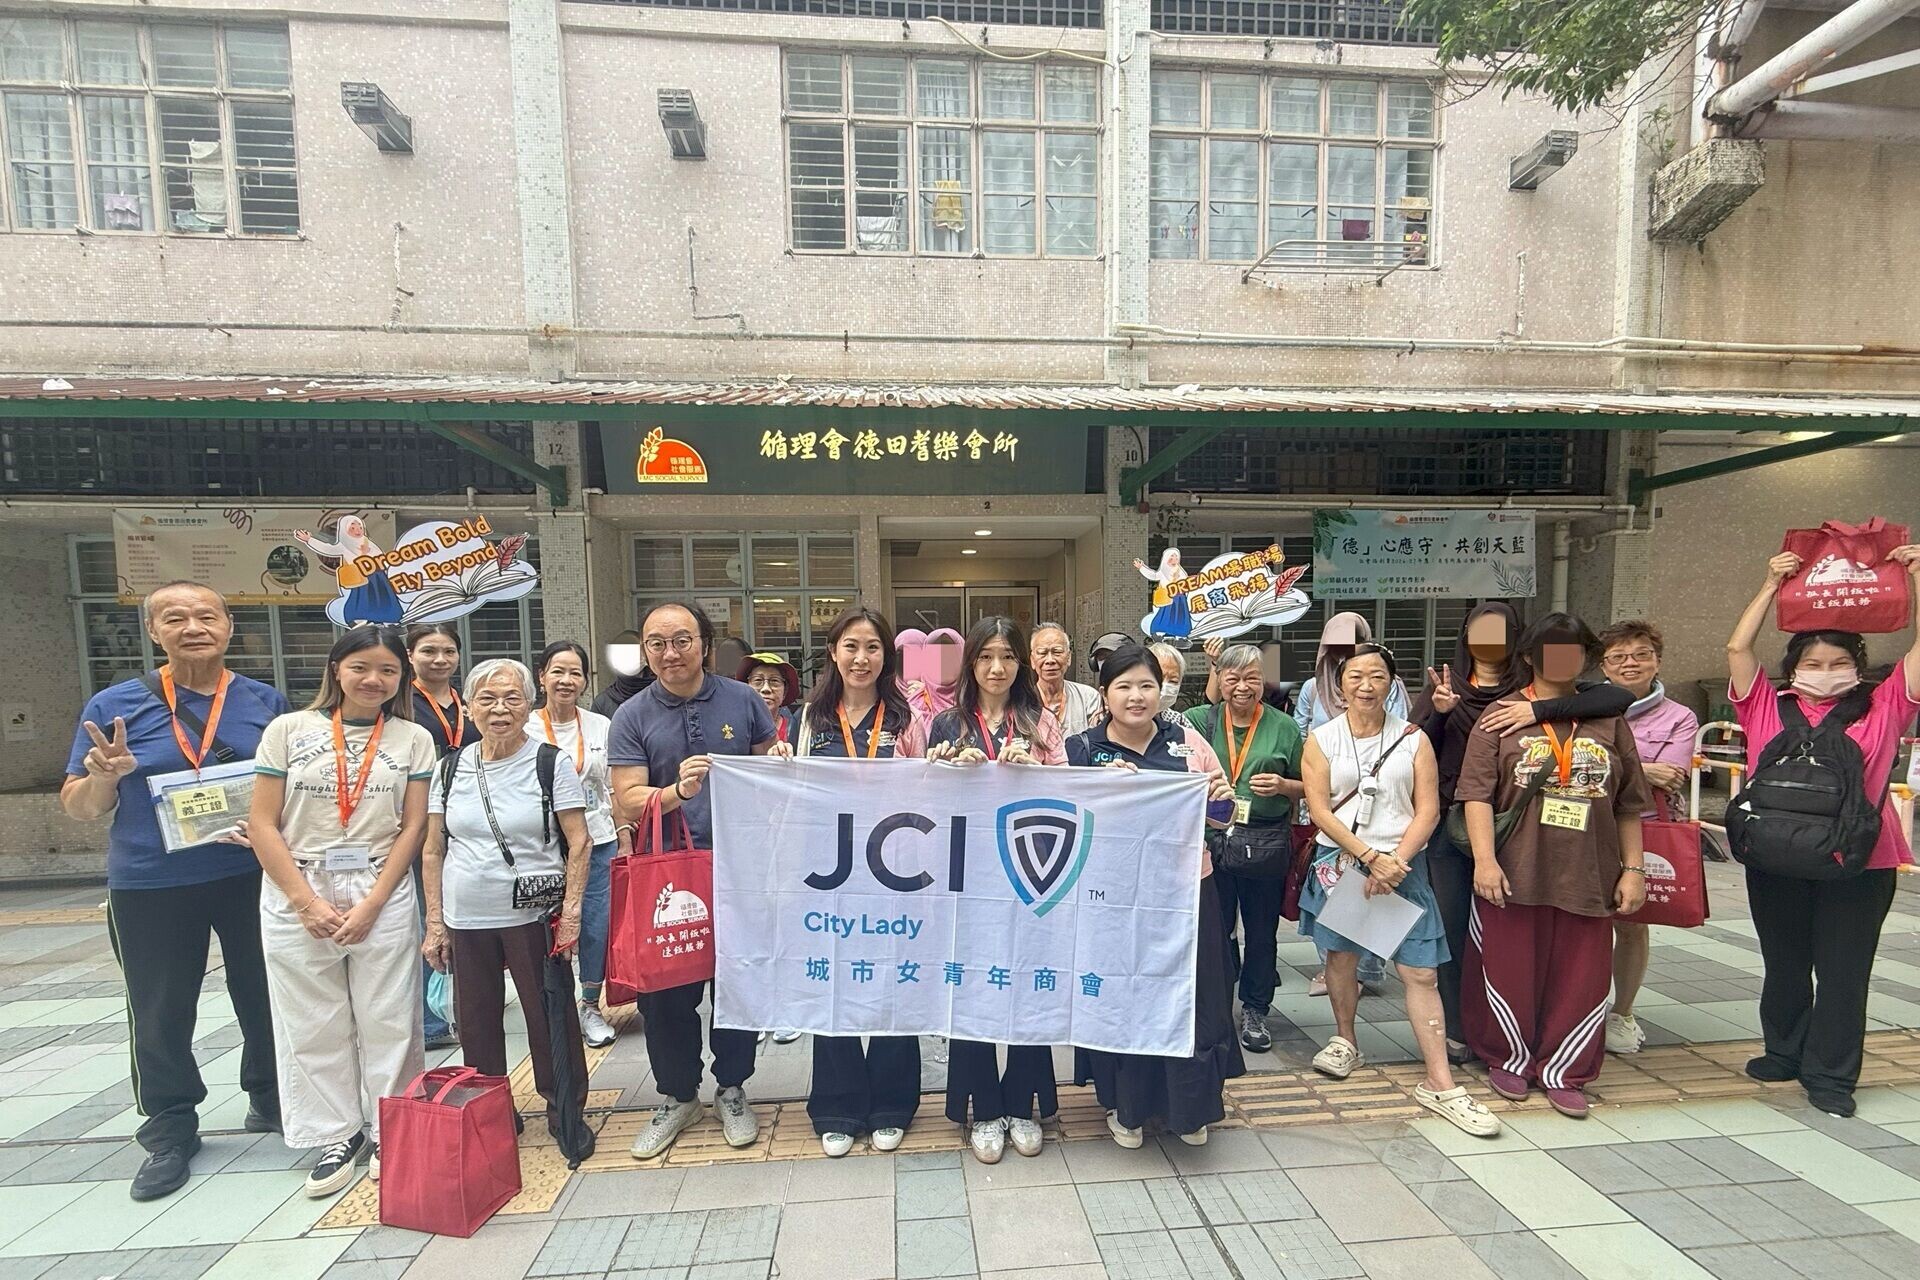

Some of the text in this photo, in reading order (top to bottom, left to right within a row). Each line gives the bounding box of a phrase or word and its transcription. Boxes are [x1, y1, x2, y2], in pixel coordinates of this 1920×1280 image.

[549, 443, 563, 455] 12
[760, 427, 1019, 462] 循理會德田耆樂會所
[1125, 449, 1138, 461] 10
[984, 501, 991, 510] 2
[354, 514, 492, 577] Dream Bold
[390, 541, 498, 595] Fly Beyond
[1094, 752, 1113, 762] JCI
[294, 781, 350, 794] Laughi
[182, 800, 222, 817] 義工證
[1546, 814, 1581, 828] 義工證
[803, 812, 967, 893] JCI
[804, 911, 924, 939] City Lady
[806, 956, 1104, 997] 城市女青年商會
